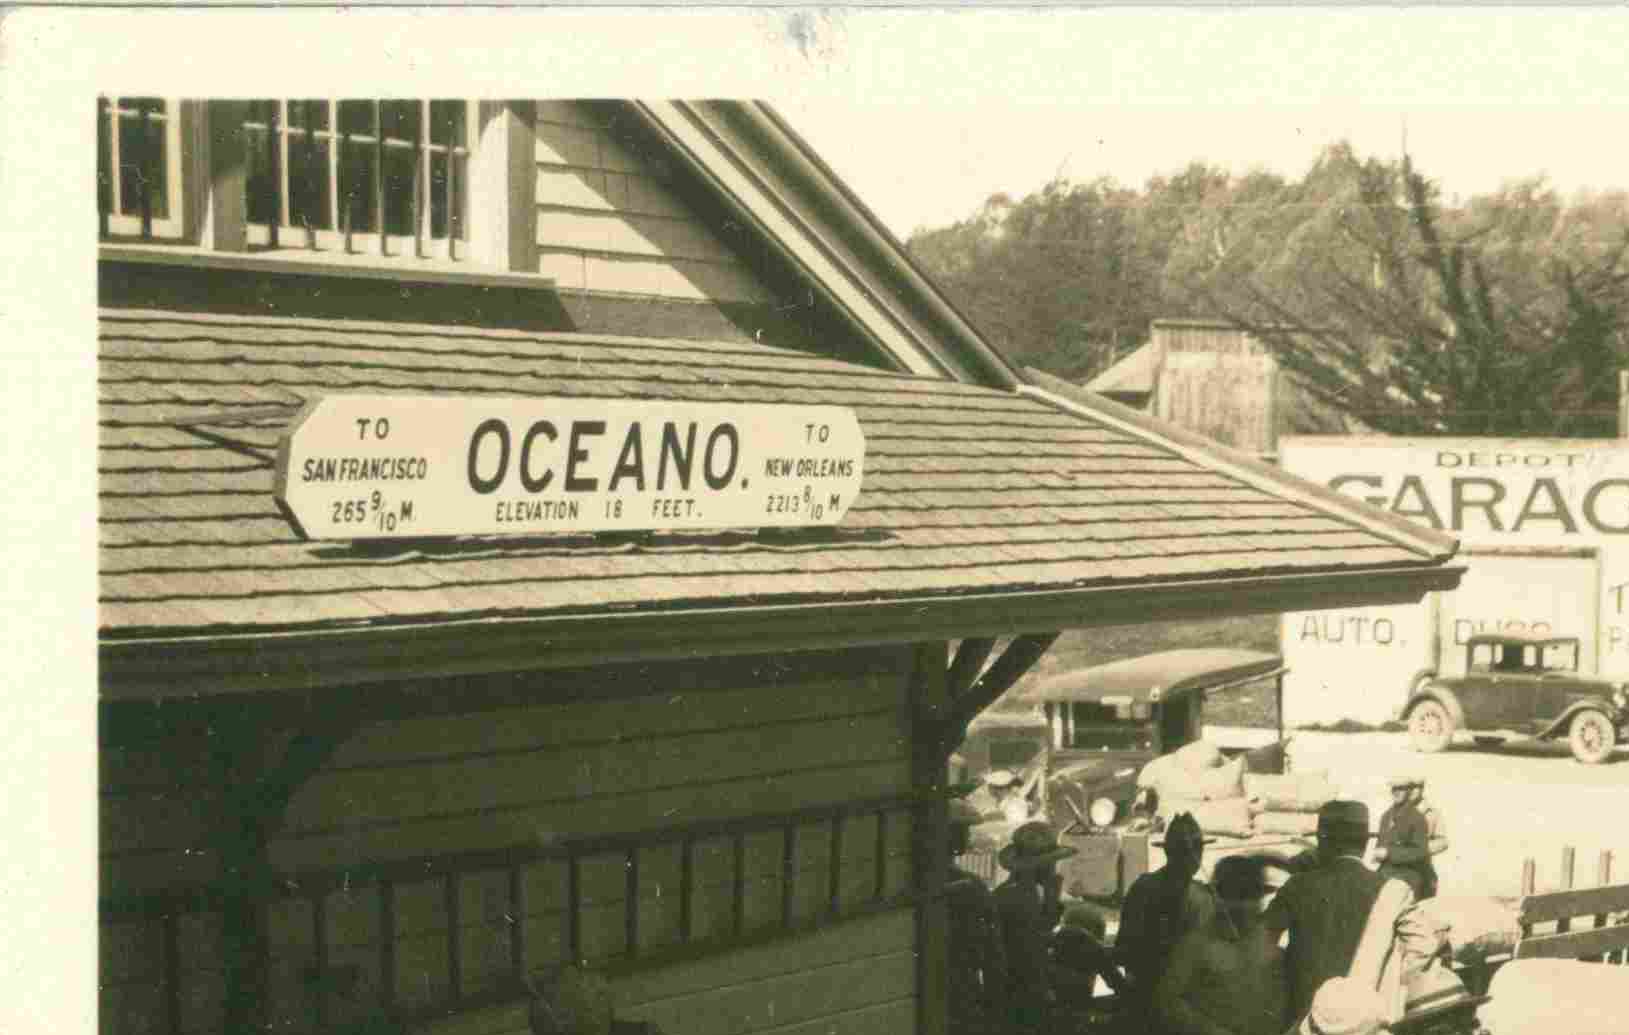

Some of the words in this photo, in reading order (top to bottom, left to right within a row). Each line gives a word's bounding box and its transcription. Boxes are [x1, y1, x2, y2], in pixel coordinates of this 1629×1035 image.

[356, 417, 390, 441] TO
[804, 423, 830, 443] TO
[466, 418, 749, 495] OCEANO.
[1435, 451, 1584, 469] DEPOT
[301, 457, 337, 483] SAN
[338, 457, 428, 482] FRANCISCO
[764, 458, 795, 478] NEW
[796, 458, 854, 478] ORLEANS
[495, 500, 579, 522] ELEVATION
[604, 500, 624, 518] 18
[651, 499, 702, 517] FEET.
[766, 494, 801, 513] 2213
